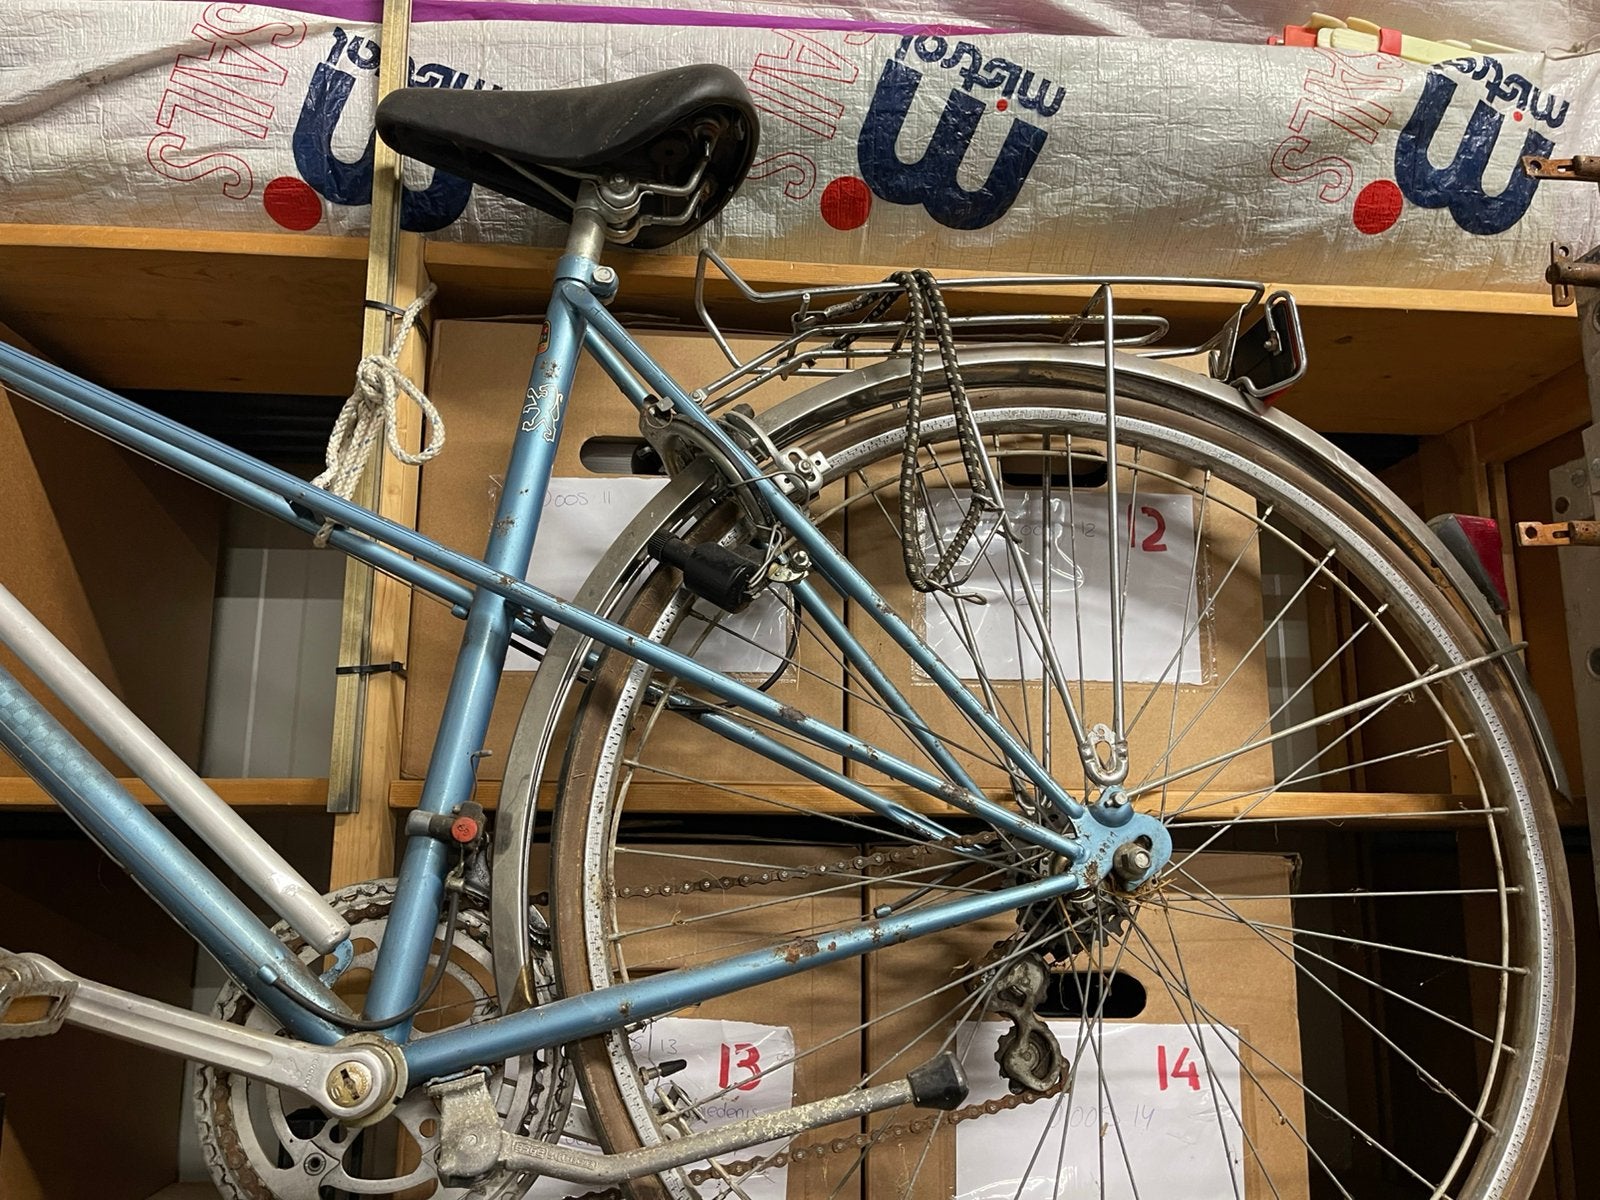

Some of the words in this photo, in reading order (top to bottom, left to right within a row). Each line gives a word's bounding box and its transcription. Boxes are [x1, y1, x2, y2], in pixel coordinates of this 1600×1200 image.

[147, 2, 307, 200] SAILS
[1081, 522, 1096, 538] 12
[1127, 503, 1168, 552] 12
[660, 1038, 678, 1055] 13
[718, 1042, 762, 1091] 13
[1157, 1045, 1201, 1091] 14
[1133, 1104, 1156, 1130] 14
